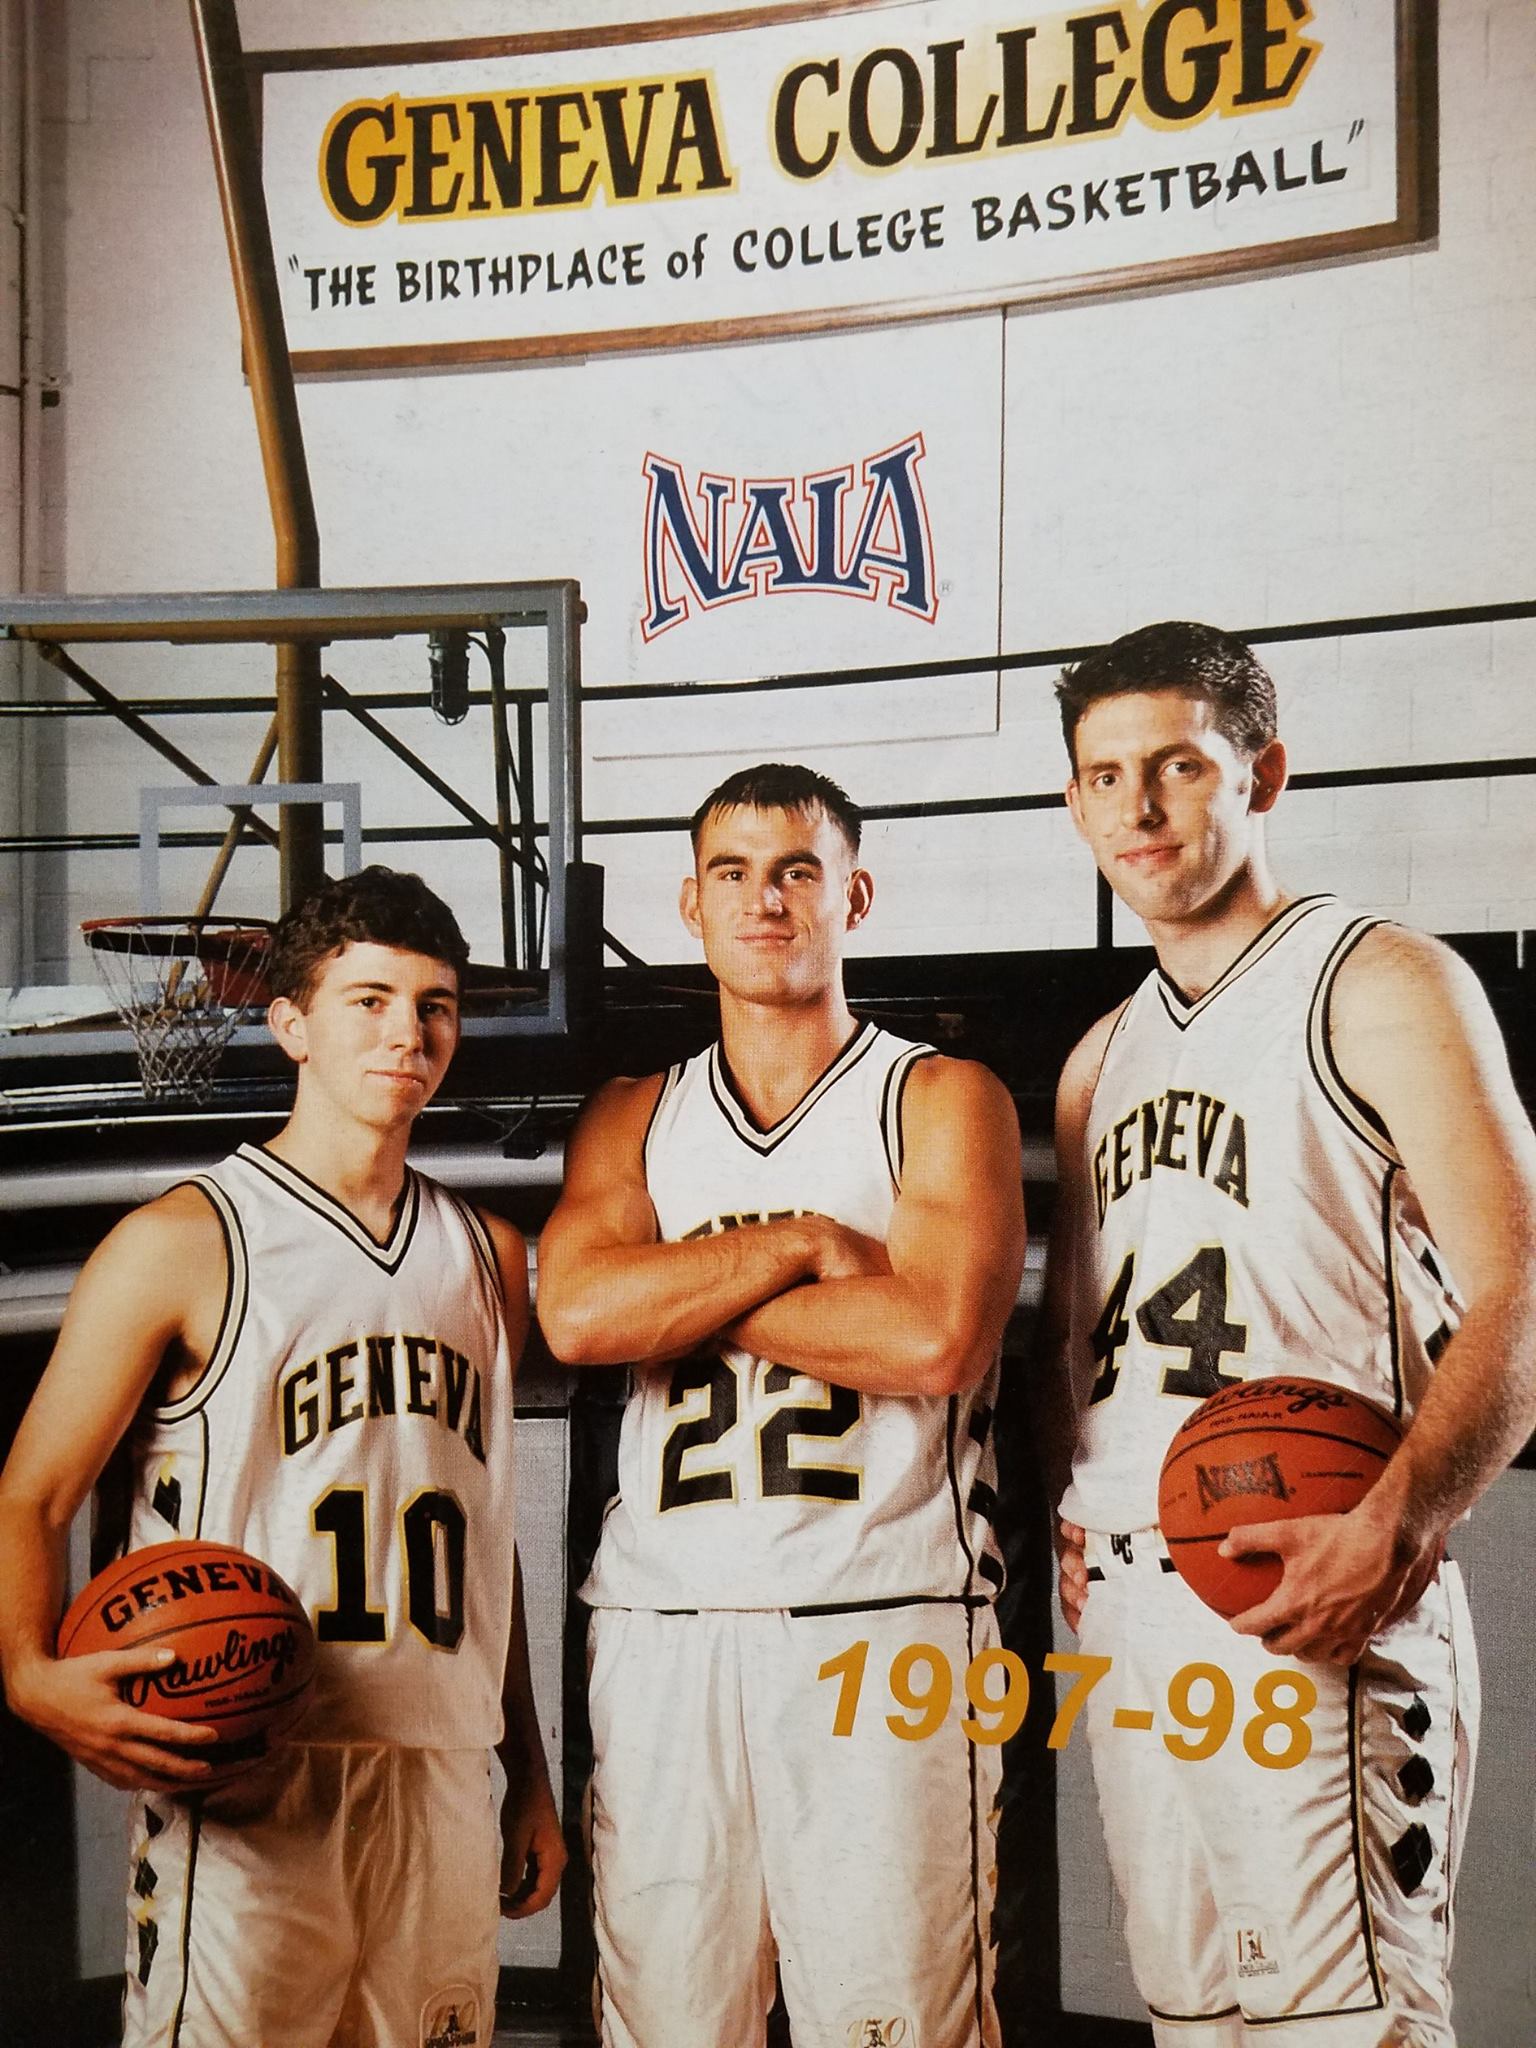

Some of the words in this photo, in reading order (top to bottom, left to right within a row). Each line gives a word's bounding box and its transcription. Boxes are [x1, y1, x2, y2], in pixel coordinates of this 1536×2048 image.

[322, 73, 735, 225] GENEVA
[771, 0, 1318, 182] COLLEGE
[395, 243, 645, 304] BIRTHPLACE
[667, 233, 708, 281] of
[733, 204, 944, 273] COLLEGE
[641, 431, 939, 643] NAIA
[1093, 1087, 1250, 1232] GENEVA
[279, 1334, 487, 1465] GENEVA
[1088, 1245, 1248, 1406] 44
[657, 1347, 865, 1514] 22
[100, 1561, 293, 1633] GENEVA
[310, 1484, 468, 1655] 10
